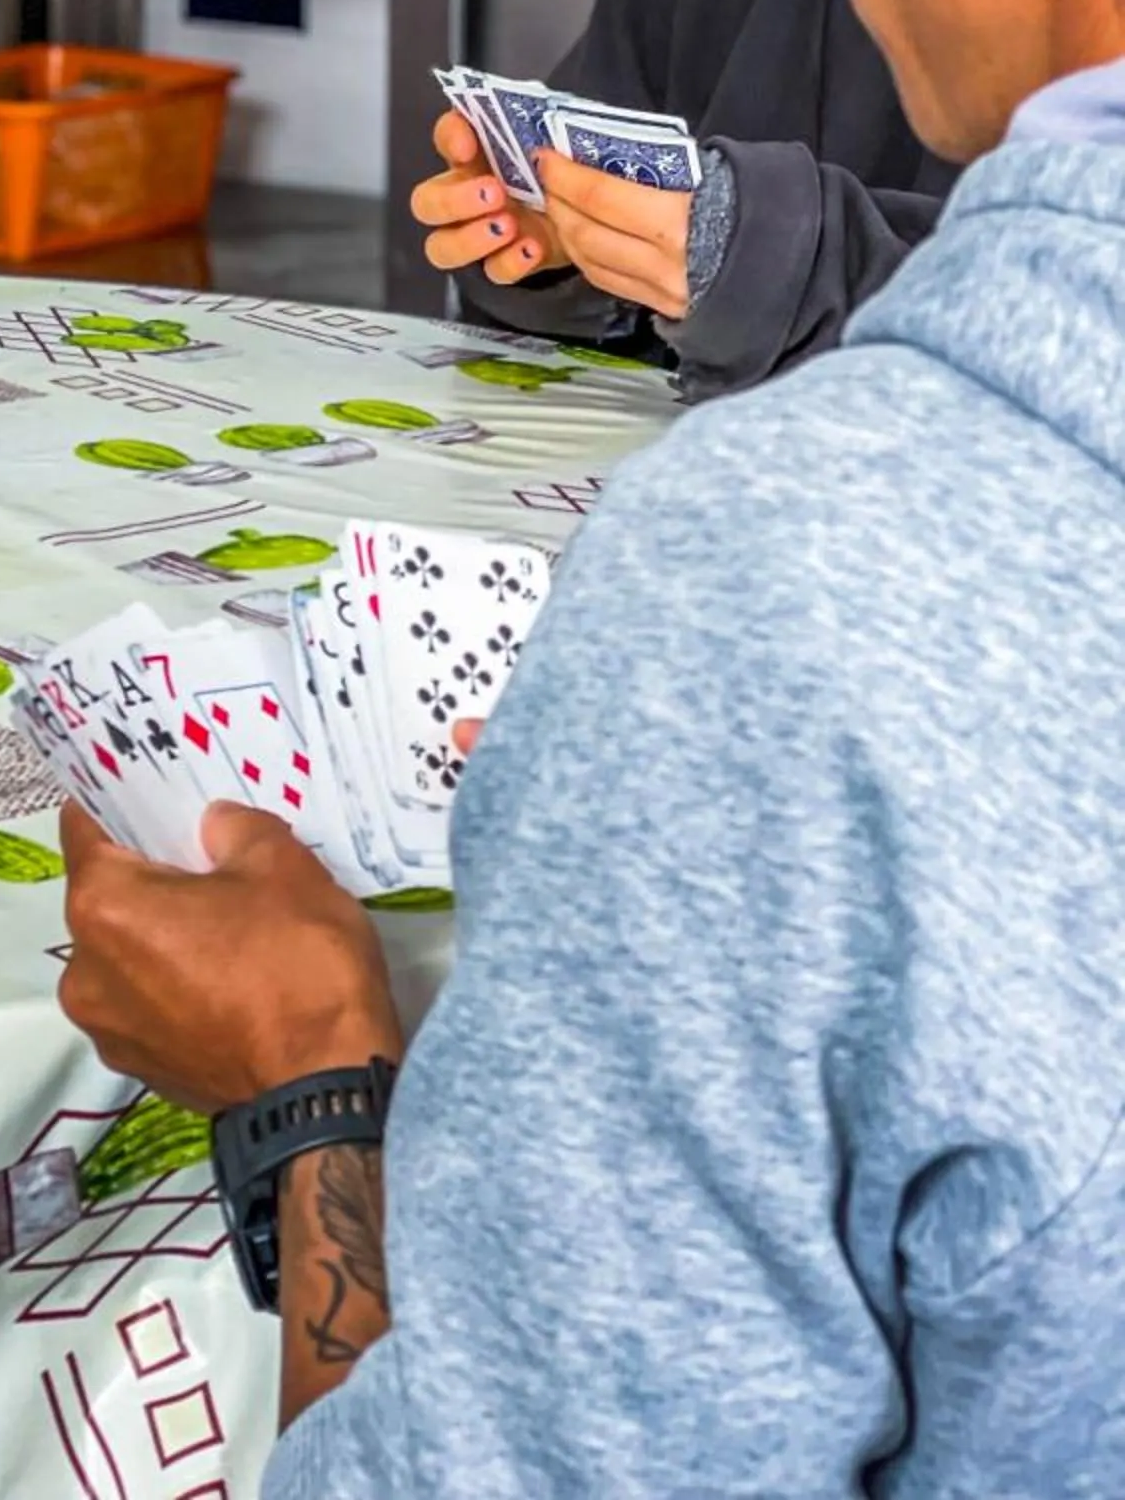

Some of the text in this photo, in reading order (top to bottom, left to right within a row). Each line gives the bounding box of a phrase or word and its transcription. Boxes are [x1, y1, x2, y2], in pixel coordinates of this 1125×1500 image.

[50, 658, 100, 709] K
[110, 659, 153, 707] A
[140, 654, 178, 701] 7
[39, 679, 88, 729] K
